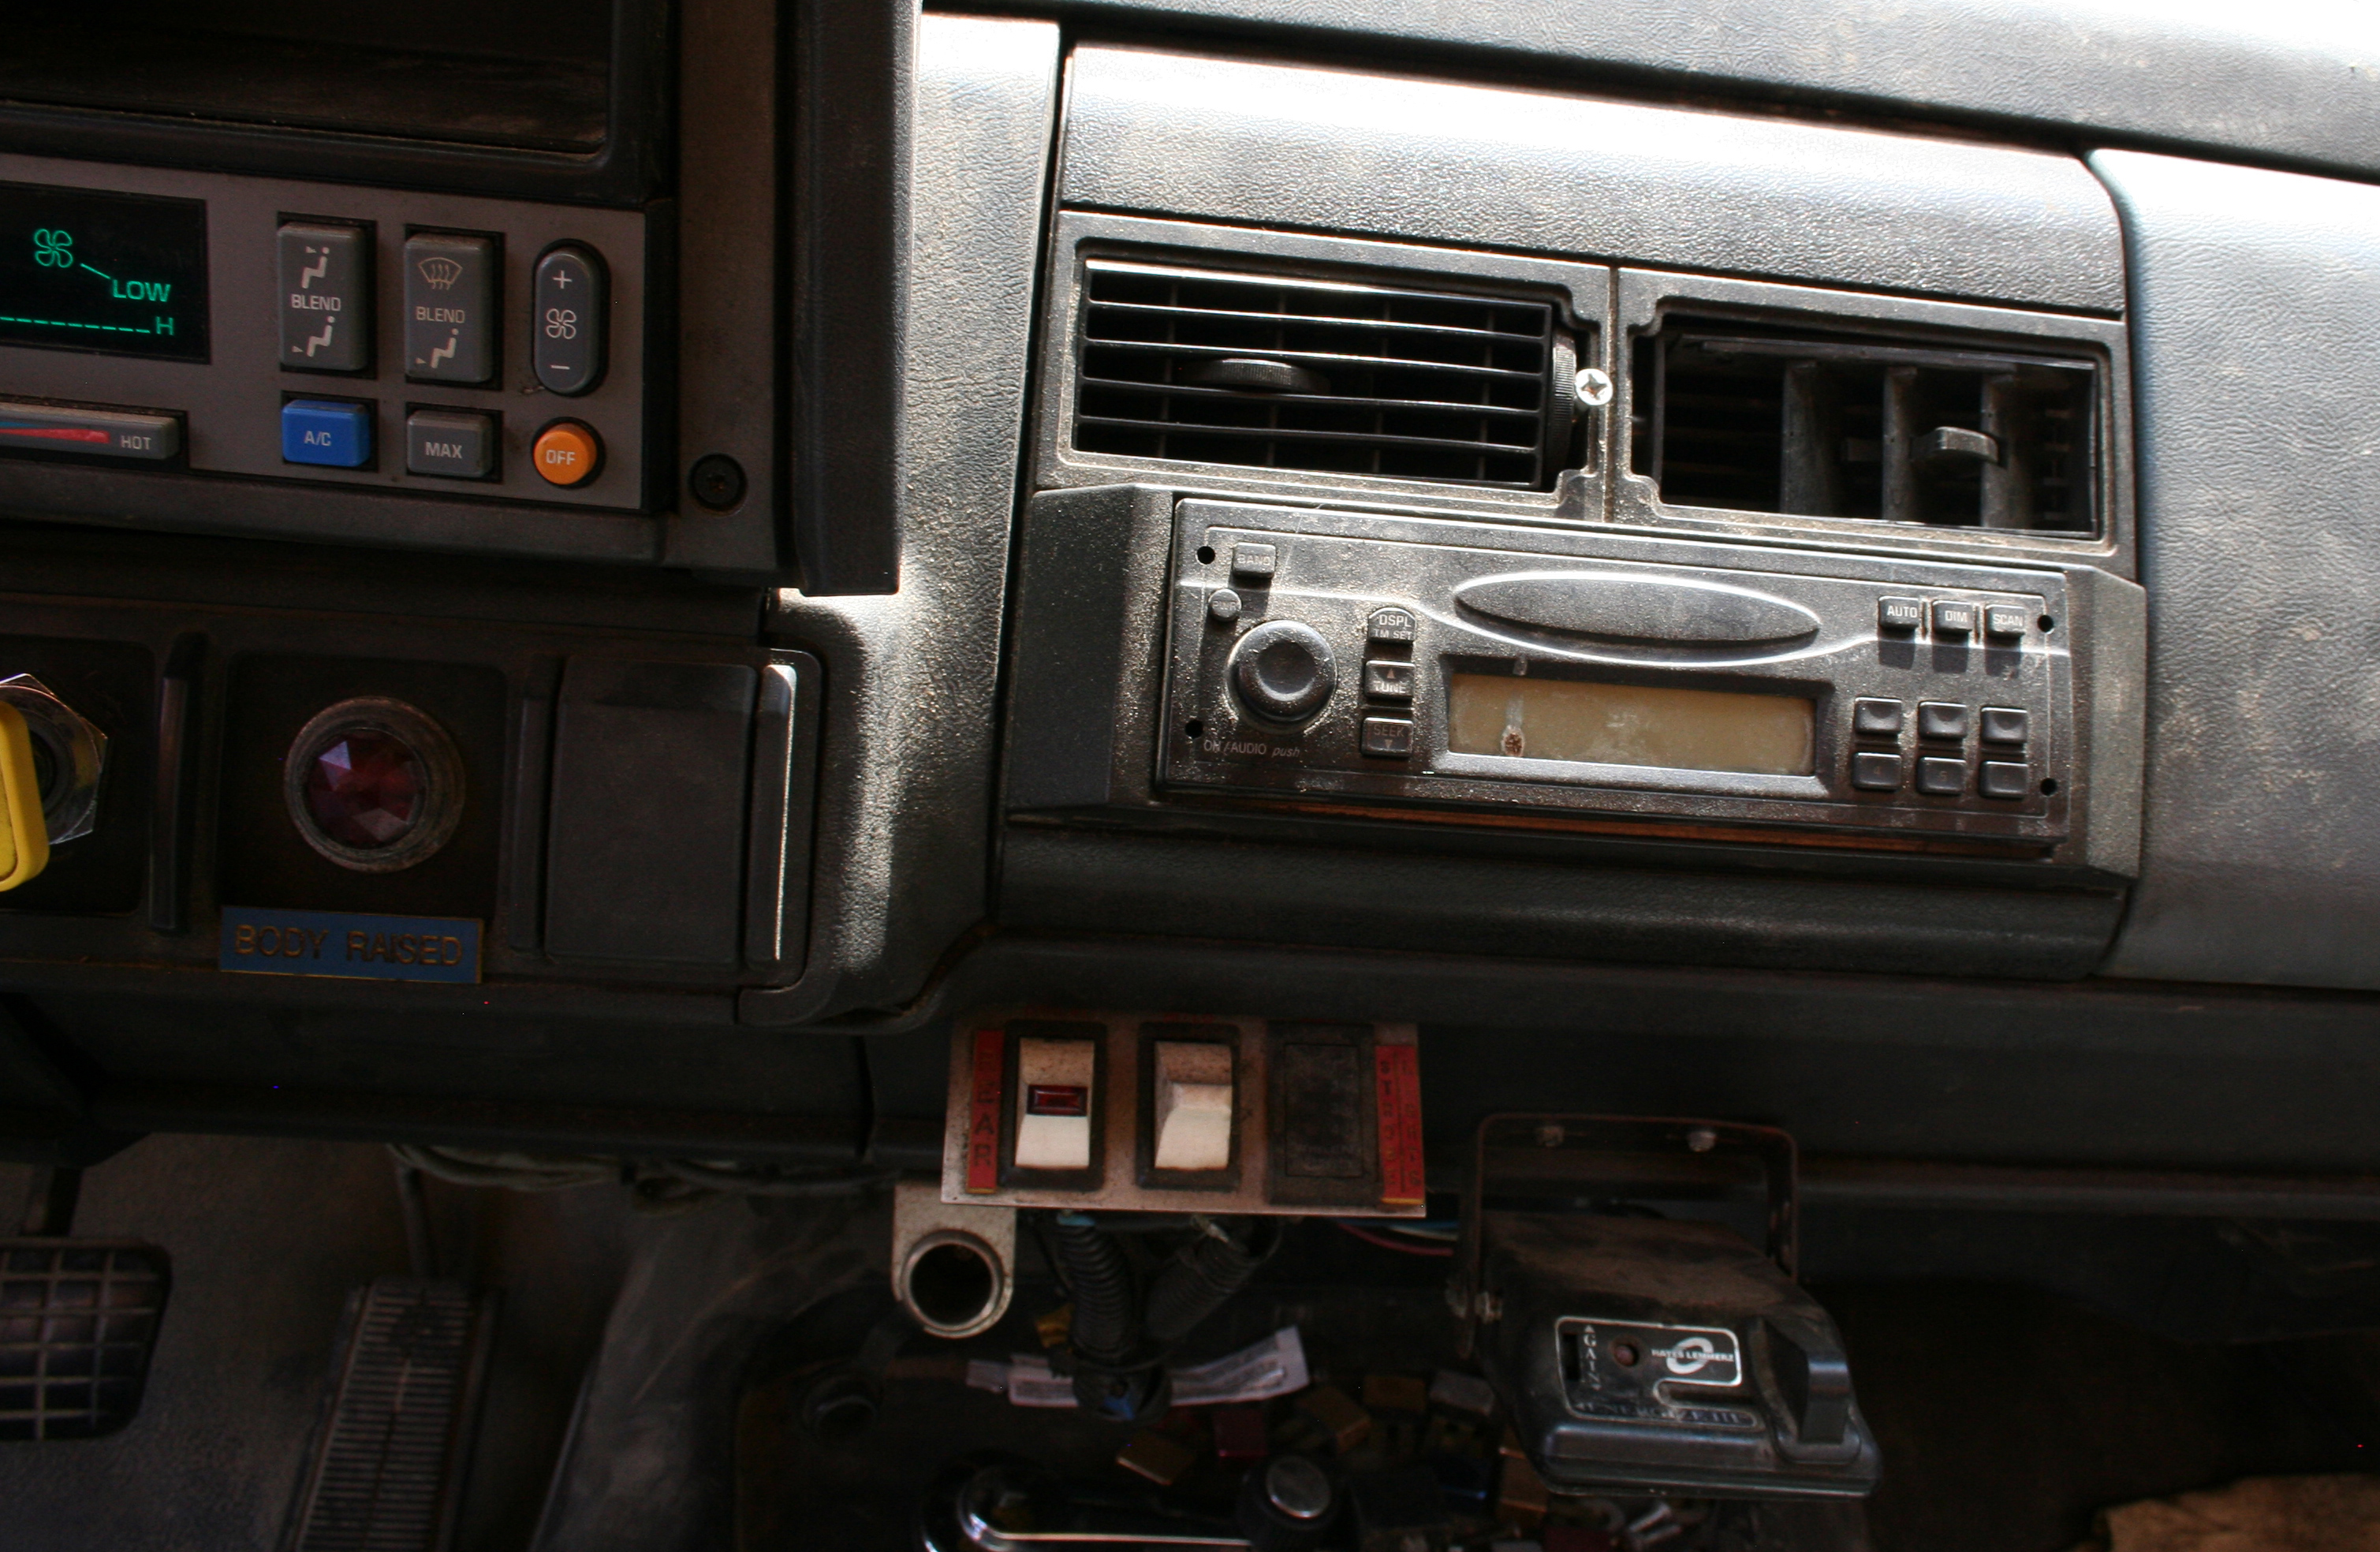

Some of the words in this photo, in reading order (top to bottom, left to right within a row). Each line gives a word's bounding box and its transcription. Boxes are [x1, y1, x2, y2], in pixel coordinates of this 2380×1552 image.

[112, 279, 172, 302] LOW
[291, 293, 341, 312] BLEND
[416, 306, 465, 324] BLEND
[155, 316, 174, 336] H
[120, 435, 151, 452] HOT
[304, 429, 332, 447] A/C
[424, 442, 463, 460] MAX
[545, 450, 578, 466] OFF
[1237, 554, 1271, 566] BAND
[1886, 605, 1919, 618] AUTO
[1945, 610, 1968, 623] DIM
[1379, 614, 1412, 628] DSPL
[1992, 613, 2024, 628] SCAN
[1393, 630, 1412, 640] SET
[1374, 680, 1407, 694] TUNE
[1373, 724, 1404, 737] SEEK
[1271, 746, 1300, 758] push
[234, 924, 328, 960] BODY
[346, 931, 462, 965] RAISED
[1583, 1334, 1602, 1383] GAIN
